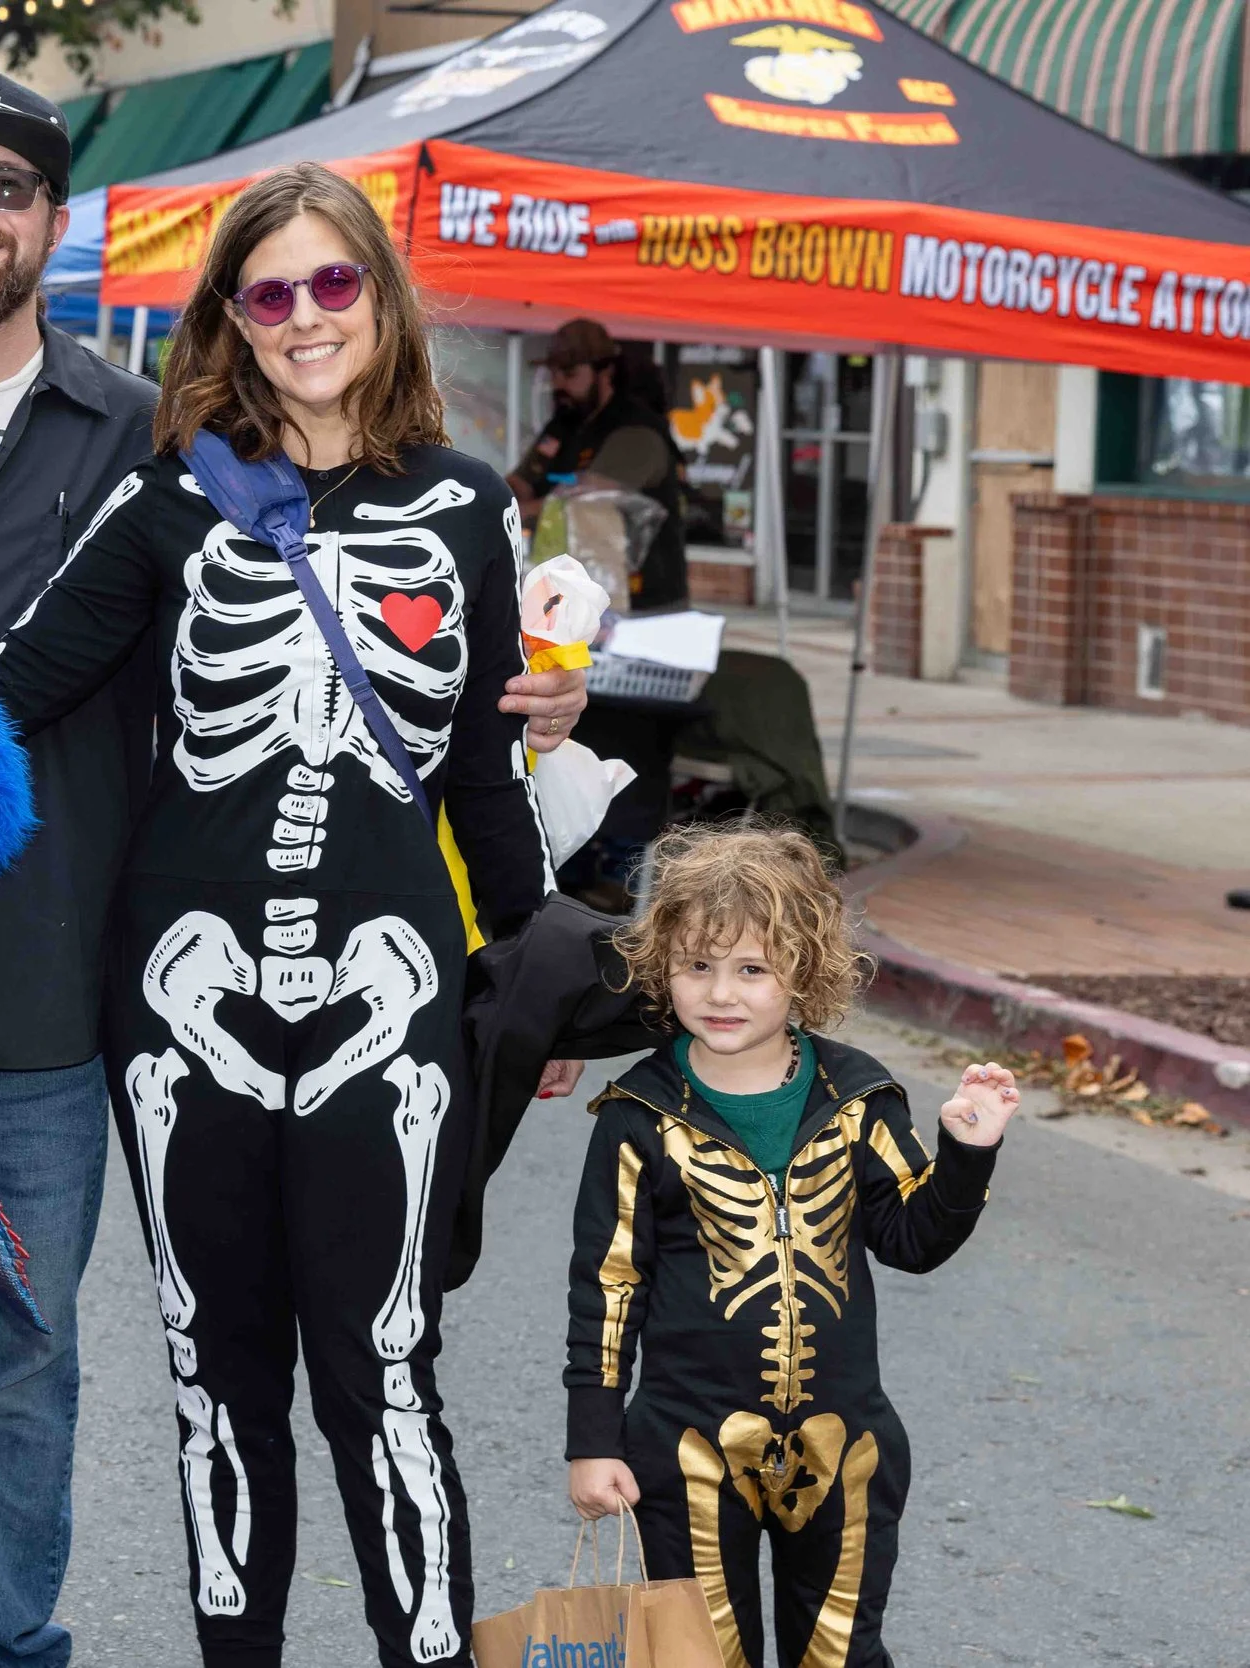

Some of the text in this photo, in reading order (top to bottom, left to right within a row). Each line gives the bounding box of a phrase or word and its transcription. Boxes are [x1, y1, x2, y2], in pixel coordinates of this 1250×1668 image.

[439, 182, 502, 247] WE
[506, 193, 591, 258] RIDE
[638, 214, 743, 275] RUSS
[750, 218, 894, 294] BROWN
[899, 233, 1147, 327] MOTORCYCLE
